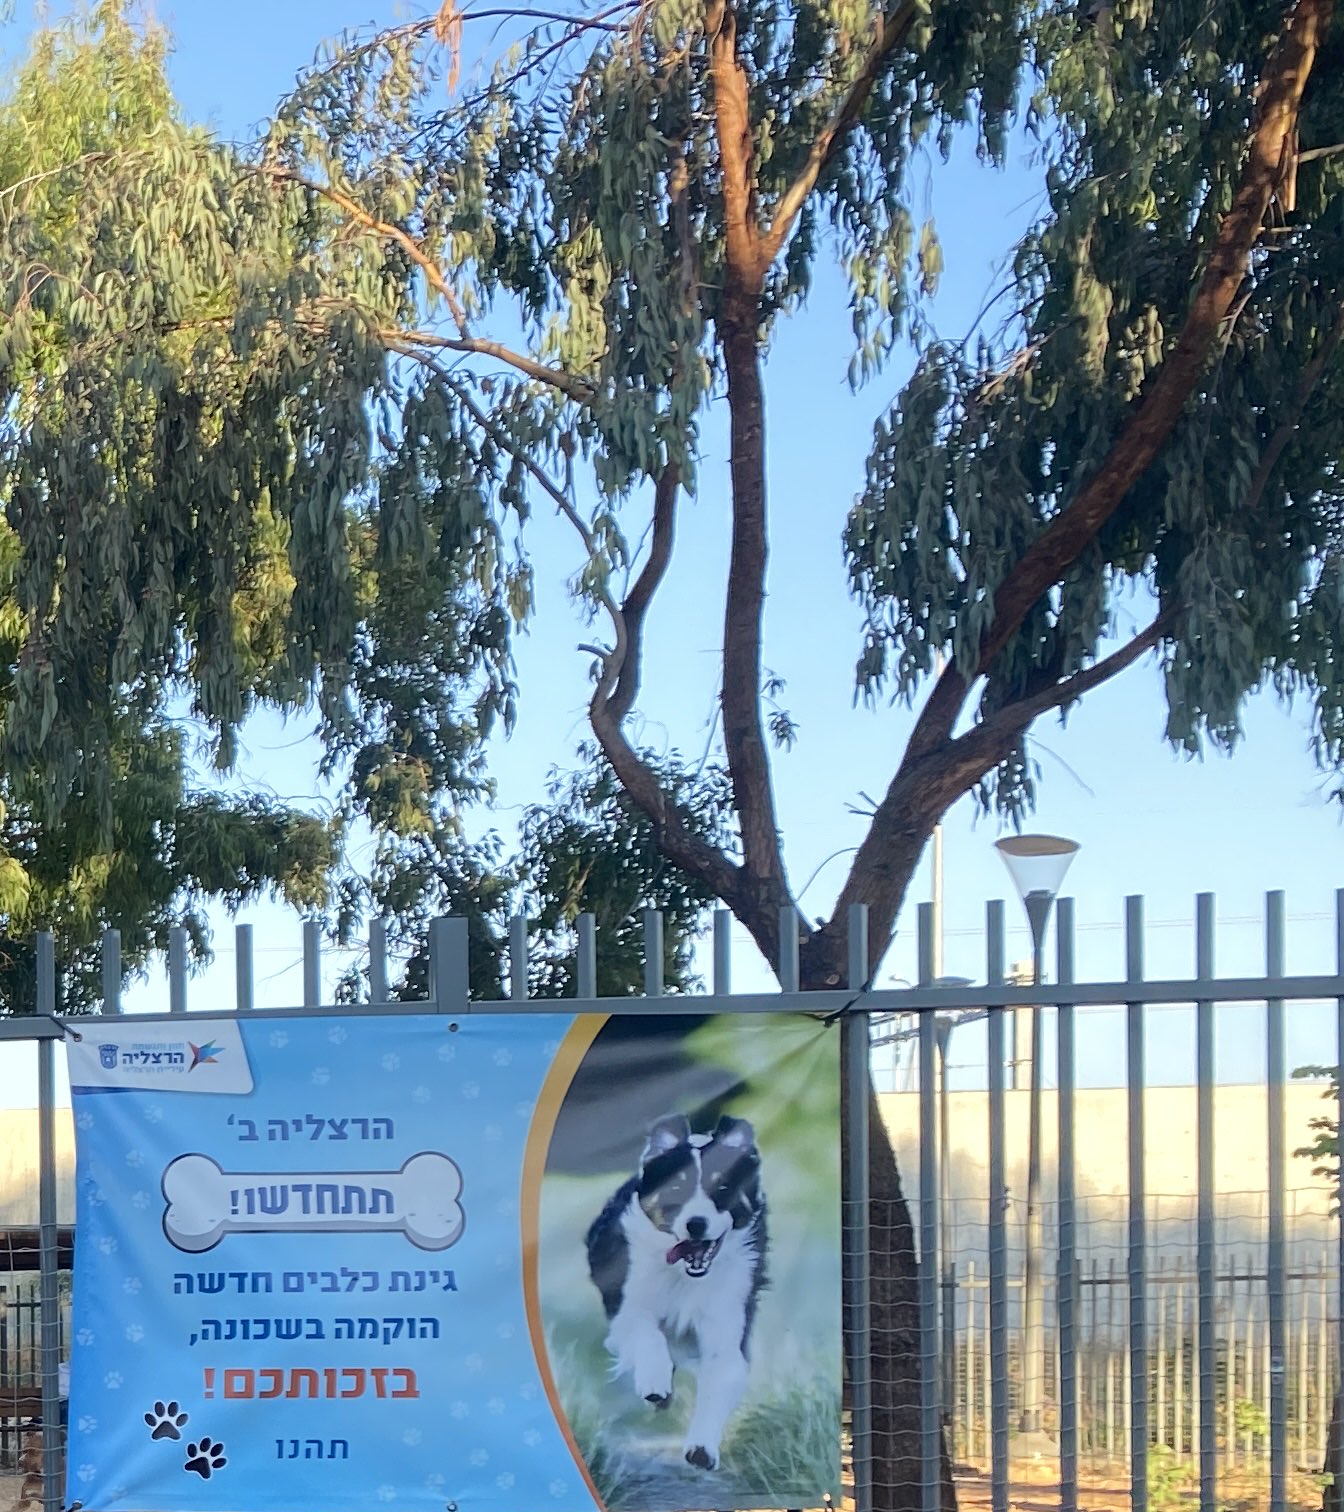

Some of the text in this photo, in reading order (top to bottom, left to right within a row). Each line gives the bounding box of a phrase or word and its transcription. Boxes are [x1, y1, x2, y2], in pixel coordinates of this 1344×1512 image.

[122, 1051, 184, 1064] הרצליה
[268, 1114, 393, 1141] הרצליה
[231, 1184, 394, 1214] תתחדשו!
[174, 1267, 458, 1294] גינת כלבים חדשה
[189, 1318, 439, 1346] הוקמה בשכונה,
[204, 1368, 420, 1399] בזכותכם!
[276, 1440, 348, 1459] תהנו
